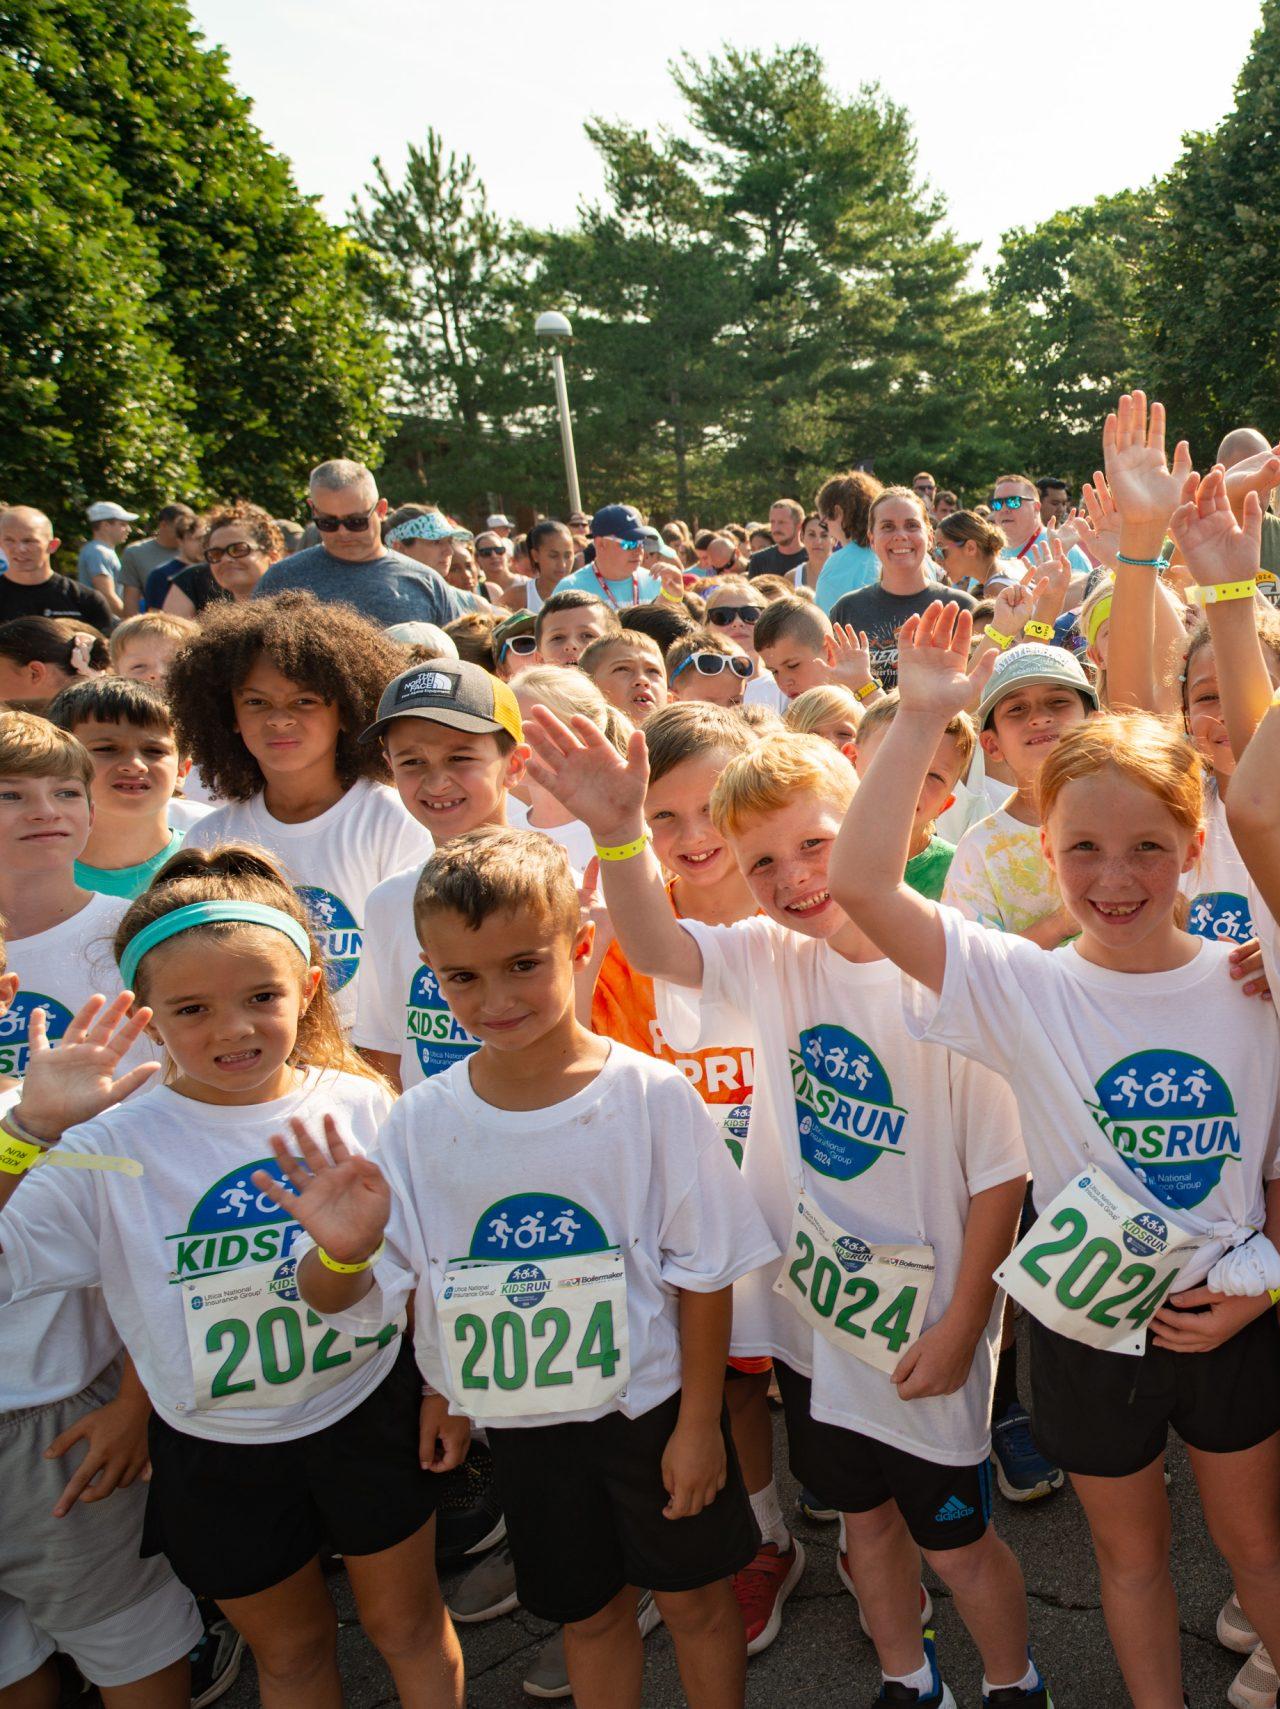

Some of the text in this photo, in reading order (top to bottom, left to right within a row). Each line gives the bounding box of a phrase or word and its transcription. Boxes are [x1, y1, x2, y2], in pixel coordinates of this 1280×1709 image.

[418, 672, 435, 680] THE
[404, 677, 434, 690] NORTH
[410, 683, 433, 692] FACE
[724, 1119, 750, 1128] KIDS
[6, 1147, 27, 1160] RUN
[813, 1149, 832, 1167] 2024
[1158, 1172, 1192, 1182] National
[1176, 1180, 1202, 1190] Group
[1121, 1219, 1168, 1252] KIDSRUN
[832, 1240, 874, 1262] KIDSRUN
[1019, 1207, 1181, 1330] 2024
[581, 1271, 624, 1284] Boilermaker
[223, 1286, 252, 1298] National
[268, 1278, 297, 1292] KIDS
[501, 1280, 552, 1294] KIDSRUN
[789, 1230, 919, 1354] 2024
[205, 1289, 262, 1307] Insurance Group
[454, 1299, 621, 1392] 2024
[935, 1506, 975, 1522] adidas
